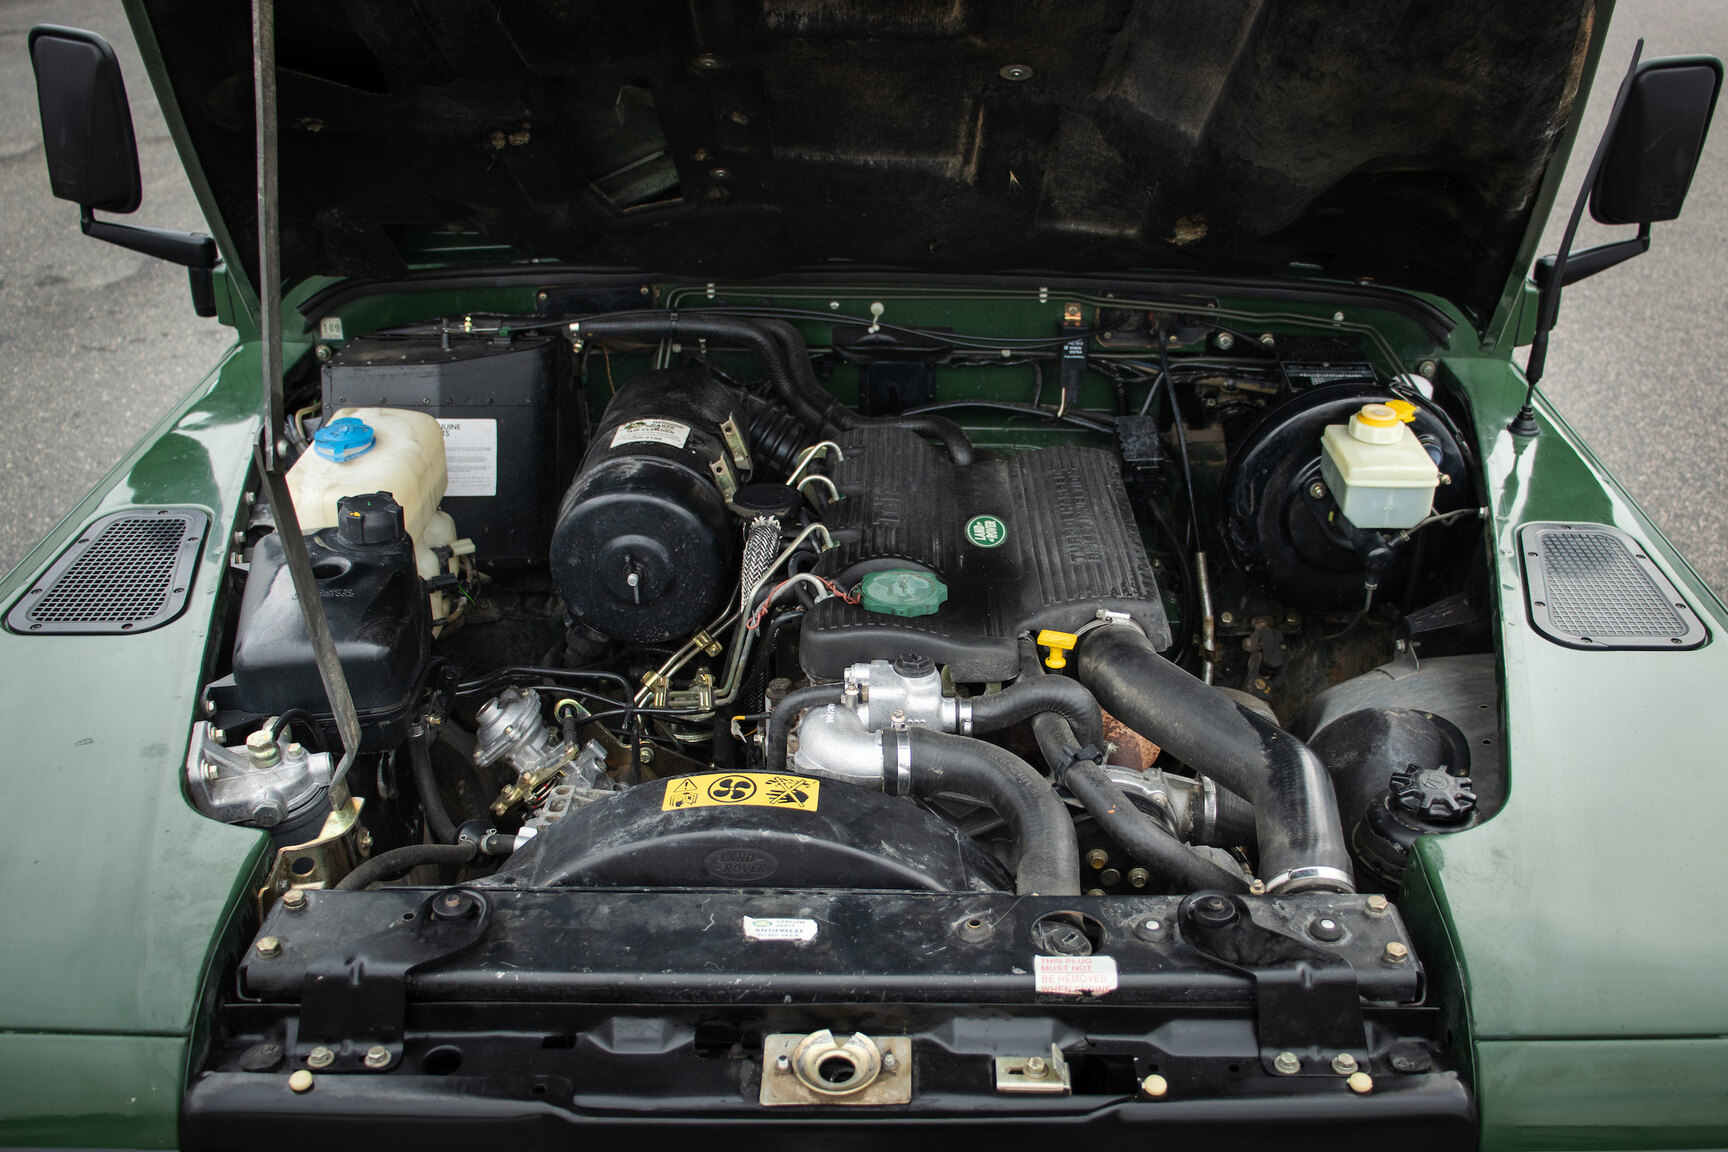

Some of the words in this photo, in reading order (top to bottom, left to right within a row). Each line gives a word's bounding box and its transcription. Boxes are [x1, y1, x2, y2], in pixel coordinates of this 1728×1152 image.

[973, 525, 986, 541] LAND
[984, 520, 998, 539] ROVER
[719, 852, 755, 864] LAND
[722, 863, 768, 873] ROVER
[1041, 975, 1055, 983] BE
[1058, 975, 1108, 983] REMOVED
